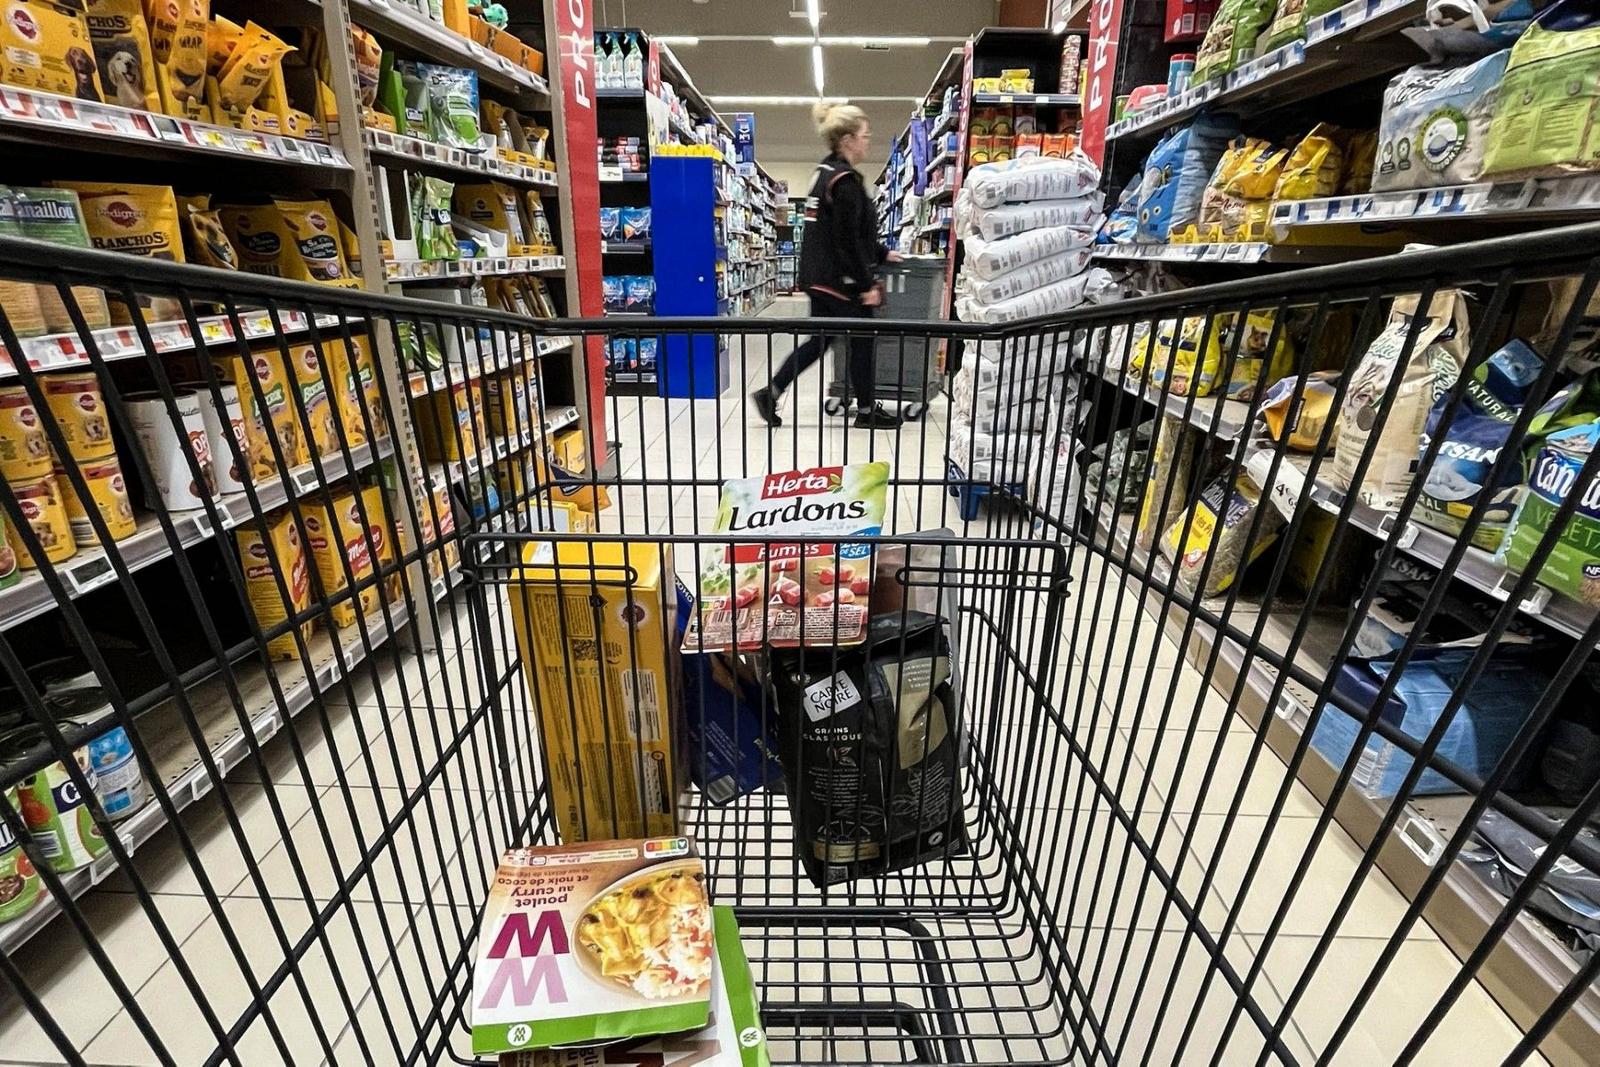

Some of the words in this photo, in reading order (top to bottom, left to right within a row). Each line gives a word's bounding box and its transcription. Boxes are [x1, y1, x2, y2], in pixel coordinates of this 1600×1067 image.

[94, 231, 164, 249] RANCHOS
[767, 474, 828, 497] Herta
[728, 497, 868, 531] Lardons
[848, 546, 867, 557] SEL
[497, 877, 527, 885] coco
[529, 877, 546, 886] de
[511, 886, 555, 897] curry
[515, 893, 569, 908] poulet
